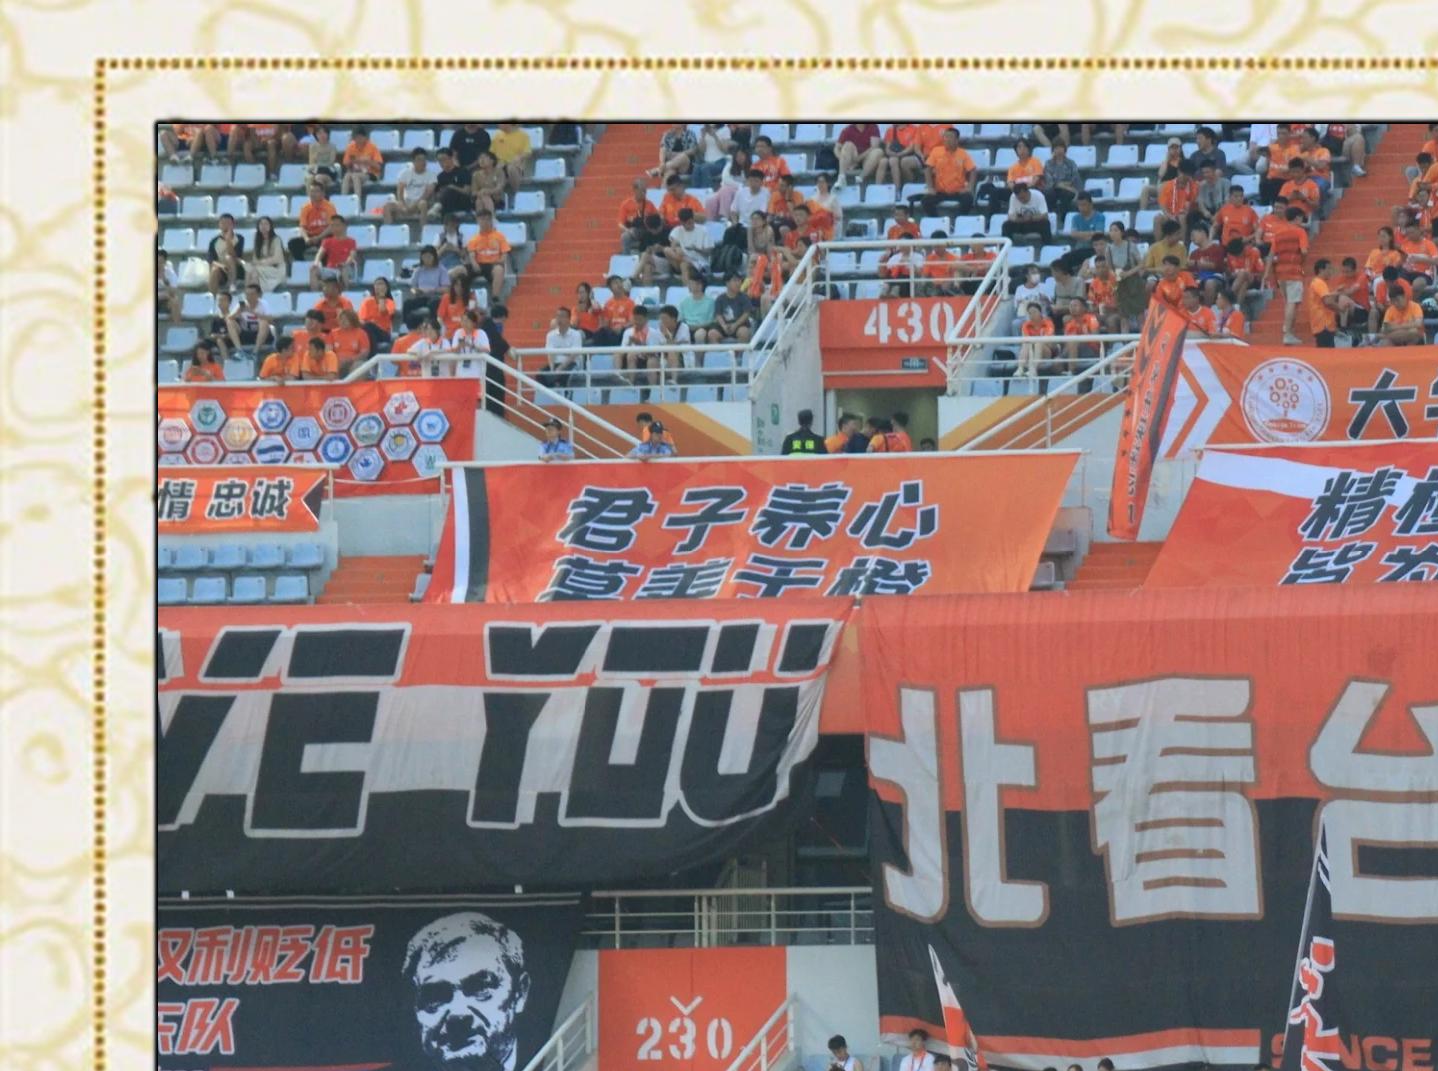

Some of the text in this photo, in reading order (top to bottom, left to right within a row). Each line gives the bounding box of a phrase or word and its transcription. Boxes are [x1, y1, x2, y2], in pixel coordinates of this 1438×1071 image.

[863, 302, 956, 344] 430
[557, 478, 939, 556] 君子养心
[635, 1016, 735, 1062] 230
